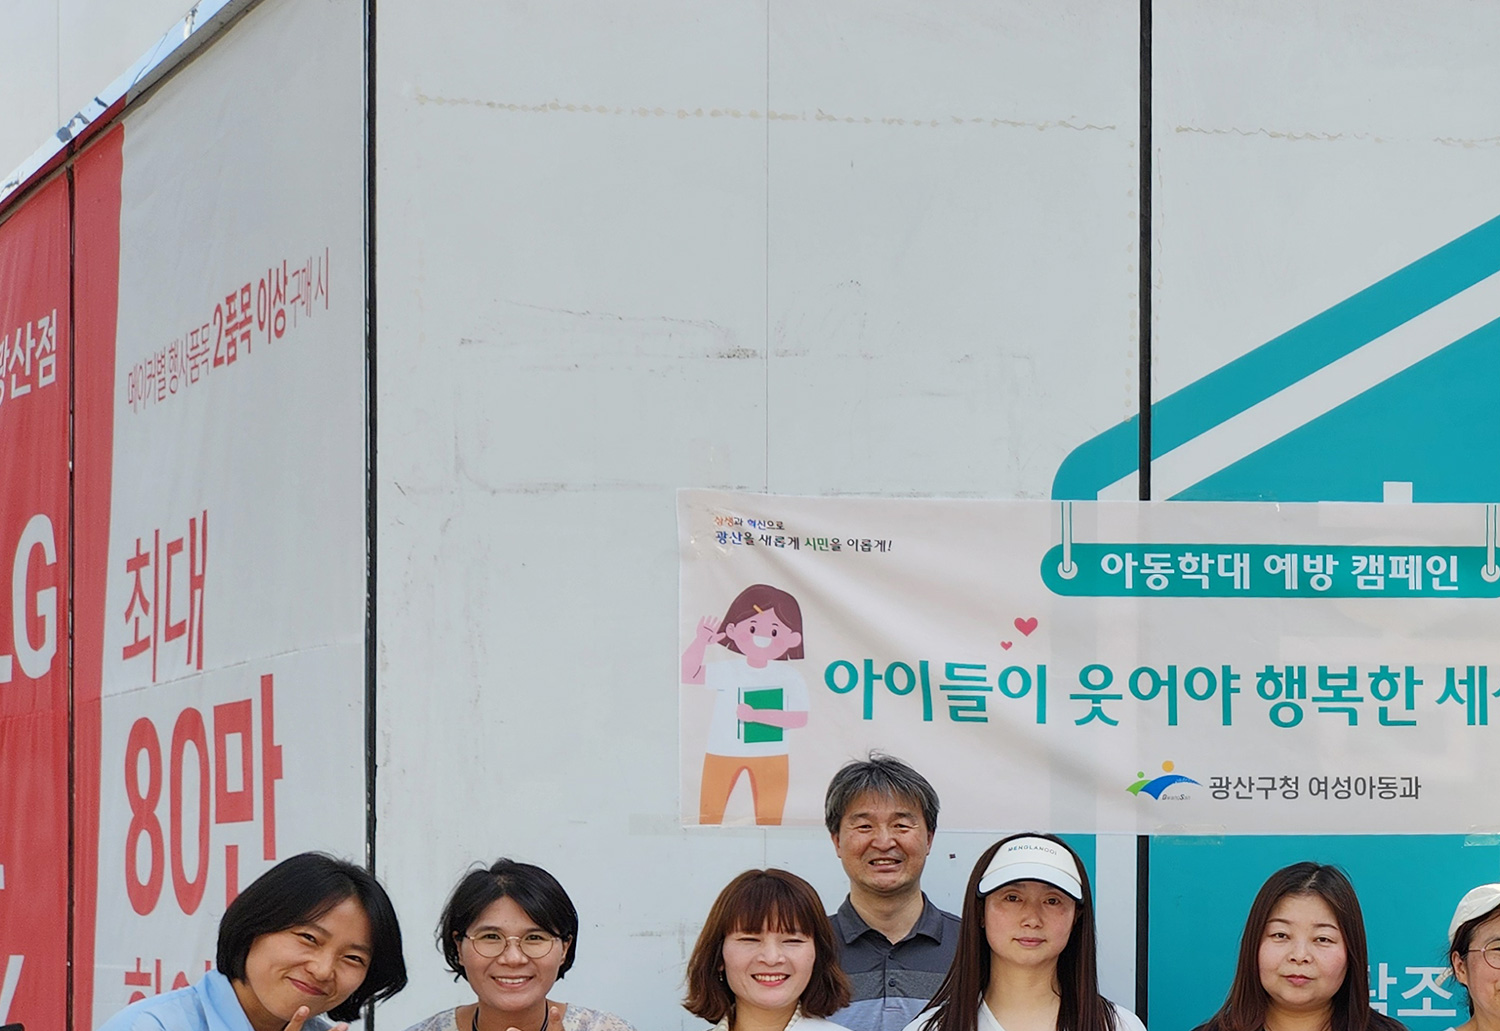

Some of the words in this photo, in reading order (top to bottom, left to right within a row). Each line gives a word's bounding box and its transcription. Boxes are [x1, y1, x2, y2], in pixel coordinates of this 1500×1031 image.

[168, 322, 211, 396] 행사품목
[213, 281, 253, 370] 2품목
[256, 258, 289, 345] 이상
[290, 255, 313, 329] 구매
[314, 246, 329, 311] 시
[122, 508, 209, 684] 최대
[715, 530, 756, 547] 광산을
[758, 532, 801, 551] 새롭게
[804, 536, 842, 552] 시민을
[1100, 551, 1252, 591] 아동학대
[1263, 553, 1340, 592] 예방
[1350, 553, 1461, 592] 캠페인
[0, 512, 58, 684] G
[824, 657, 1048, 726] 아이들이
[1068, 662, 1241, 729] 웃어야
[1255, 663, 1424, 730] 행복한
[124, 674, 284, 916] 80만
[1208, 775, 1300, 801] 광산구청
[1307, 775, 1423, 801] 여성아동과
